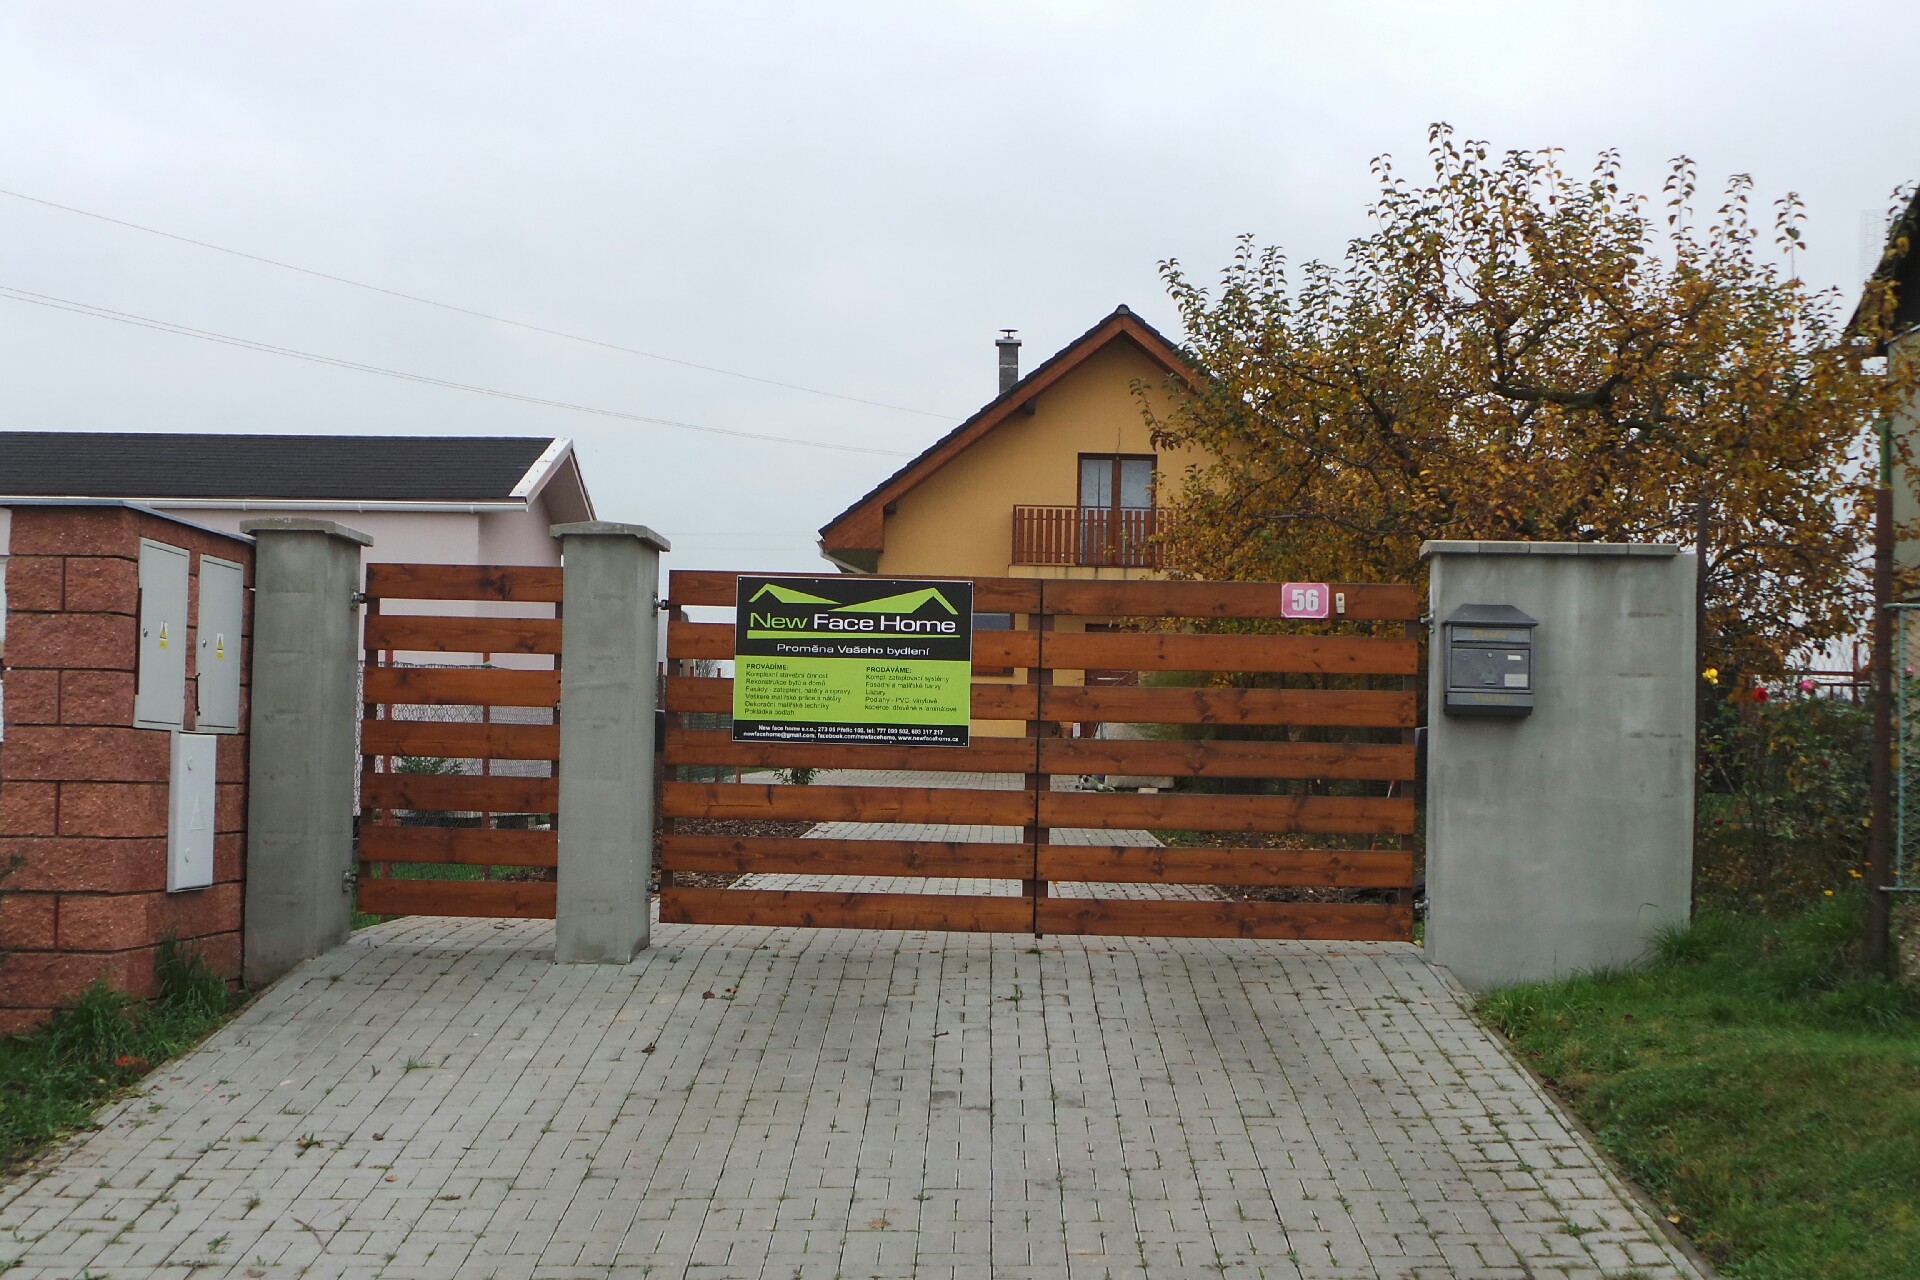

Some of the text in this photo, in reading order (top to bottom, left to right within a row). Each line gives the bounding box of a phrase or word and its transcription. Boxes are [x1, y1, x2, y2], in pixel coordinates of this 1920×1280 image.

[1292, 590, 1318, 611] 56
[749, 612, 956, 633] New Face Home
[777, 644, 930, 657] Proměna Vašeho bydlení
